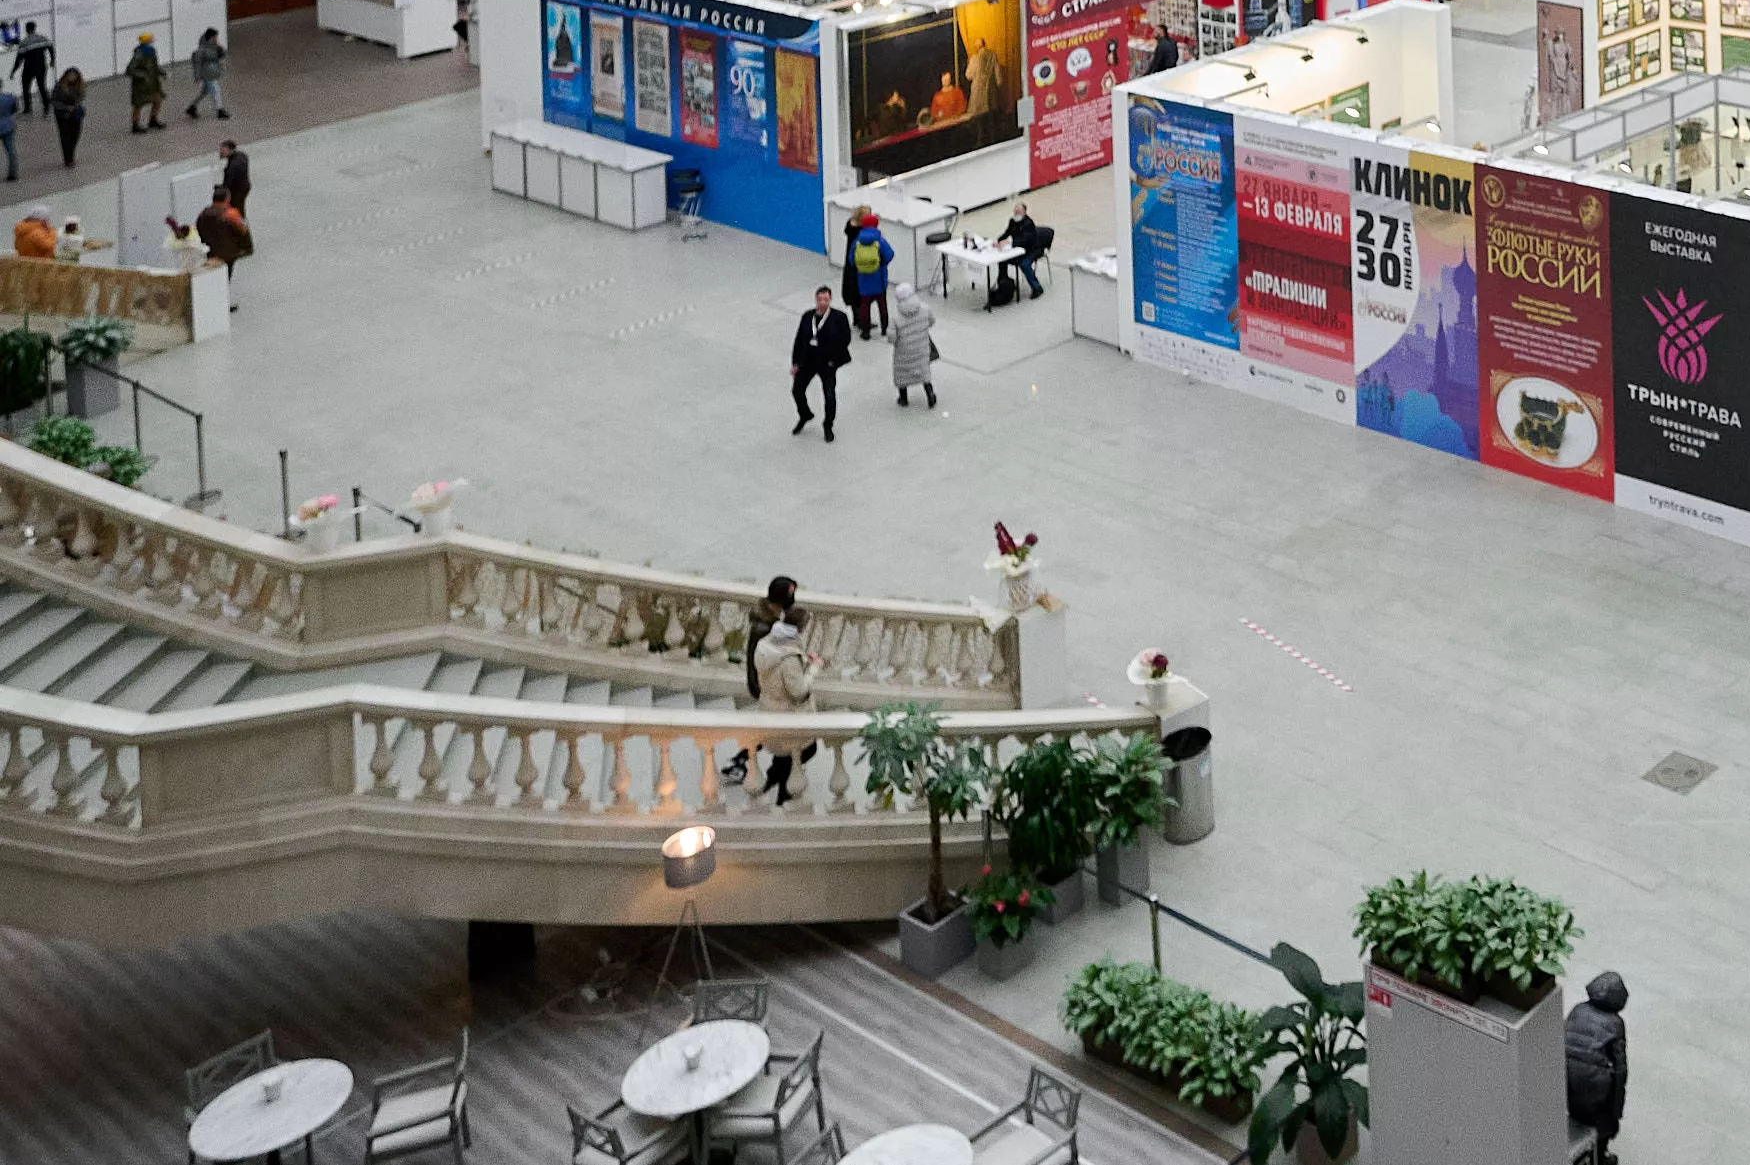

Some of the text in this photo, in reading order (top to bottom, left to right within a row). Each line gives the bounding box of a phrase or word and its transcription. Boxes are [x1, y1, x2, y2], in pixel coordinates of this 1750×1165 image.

[700, 9, 766, 35] РОССИЯ
[1155, 147, 1221, 183] РОССИЯ
[1243, 175, 1318, 209] 27 ЯНВАРЯ
[1354, 157, 1473, 216] КЛИНОК
[1274, 201, 1343, 236] ФЕВРАЛЯ
[1356, 209, 1399, 250] 27
[1644, 221, 1718, 249] ЕЖЕГОДНАЯ
[1357, 246, 1401, 287] 30
[1403, 222, 1413, 290] ЯНВАРЯ
[1558, 241, 1600, 269] РУКИ
[1650, 240, 1712, 264] ВЫСТАВКА
[1488, 245, 1601, 299] РОССИИ
[1669, 442, 1700, 458] СТИЛЬ
[1649, 495, 1725, 525] tryntrava.com
